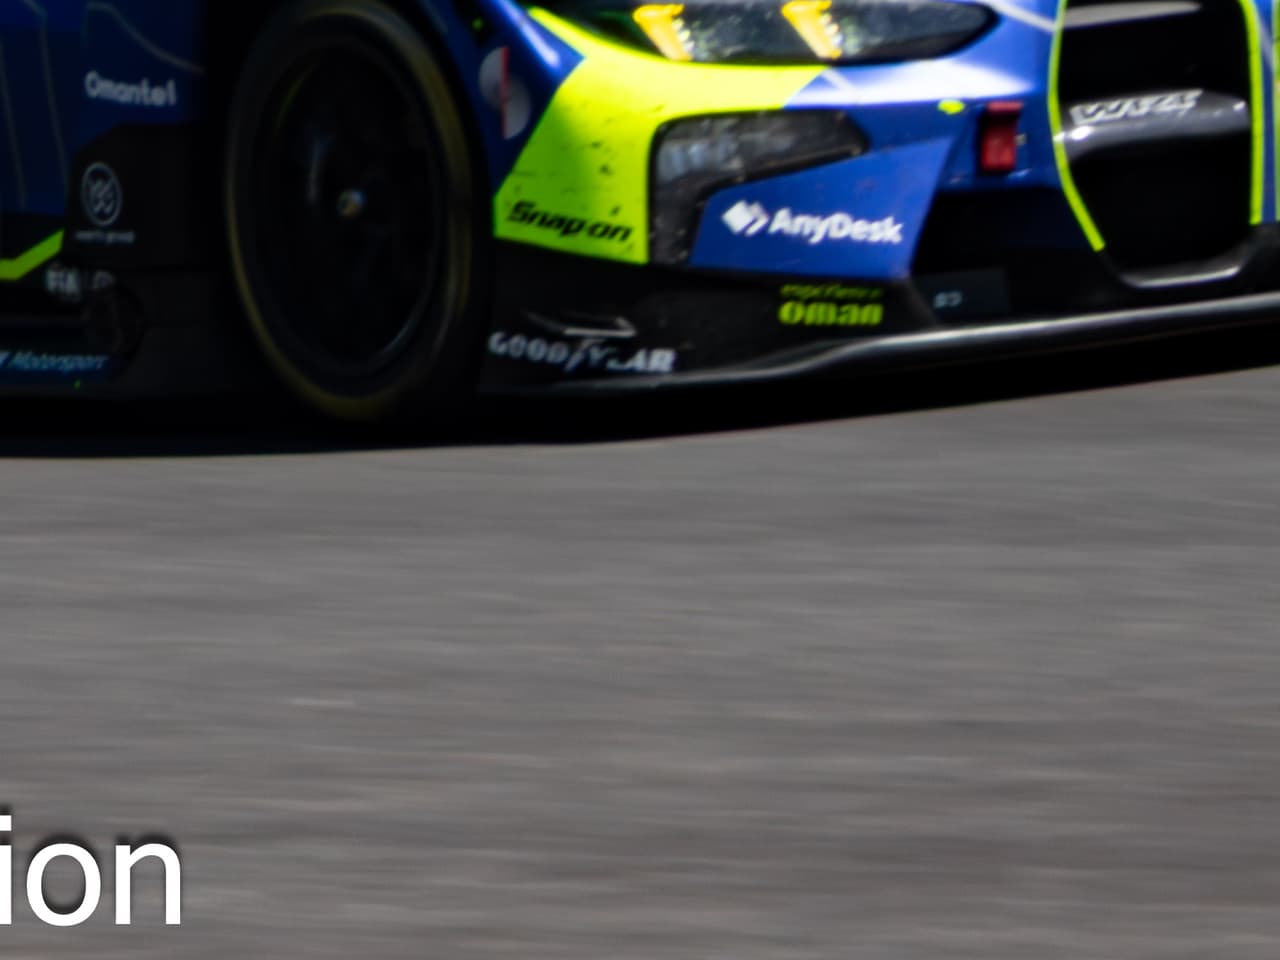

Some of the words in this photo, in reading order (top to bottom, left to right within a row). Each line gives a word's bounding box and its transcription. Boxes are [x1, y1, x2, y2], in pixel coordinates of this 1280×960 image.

[83, 69, 178, 108] Omantel
[506, 199, 633, 243] Snap-on
[769, 207, 904, 245] AnyDesk
[776, 301, 886, 327] oman
